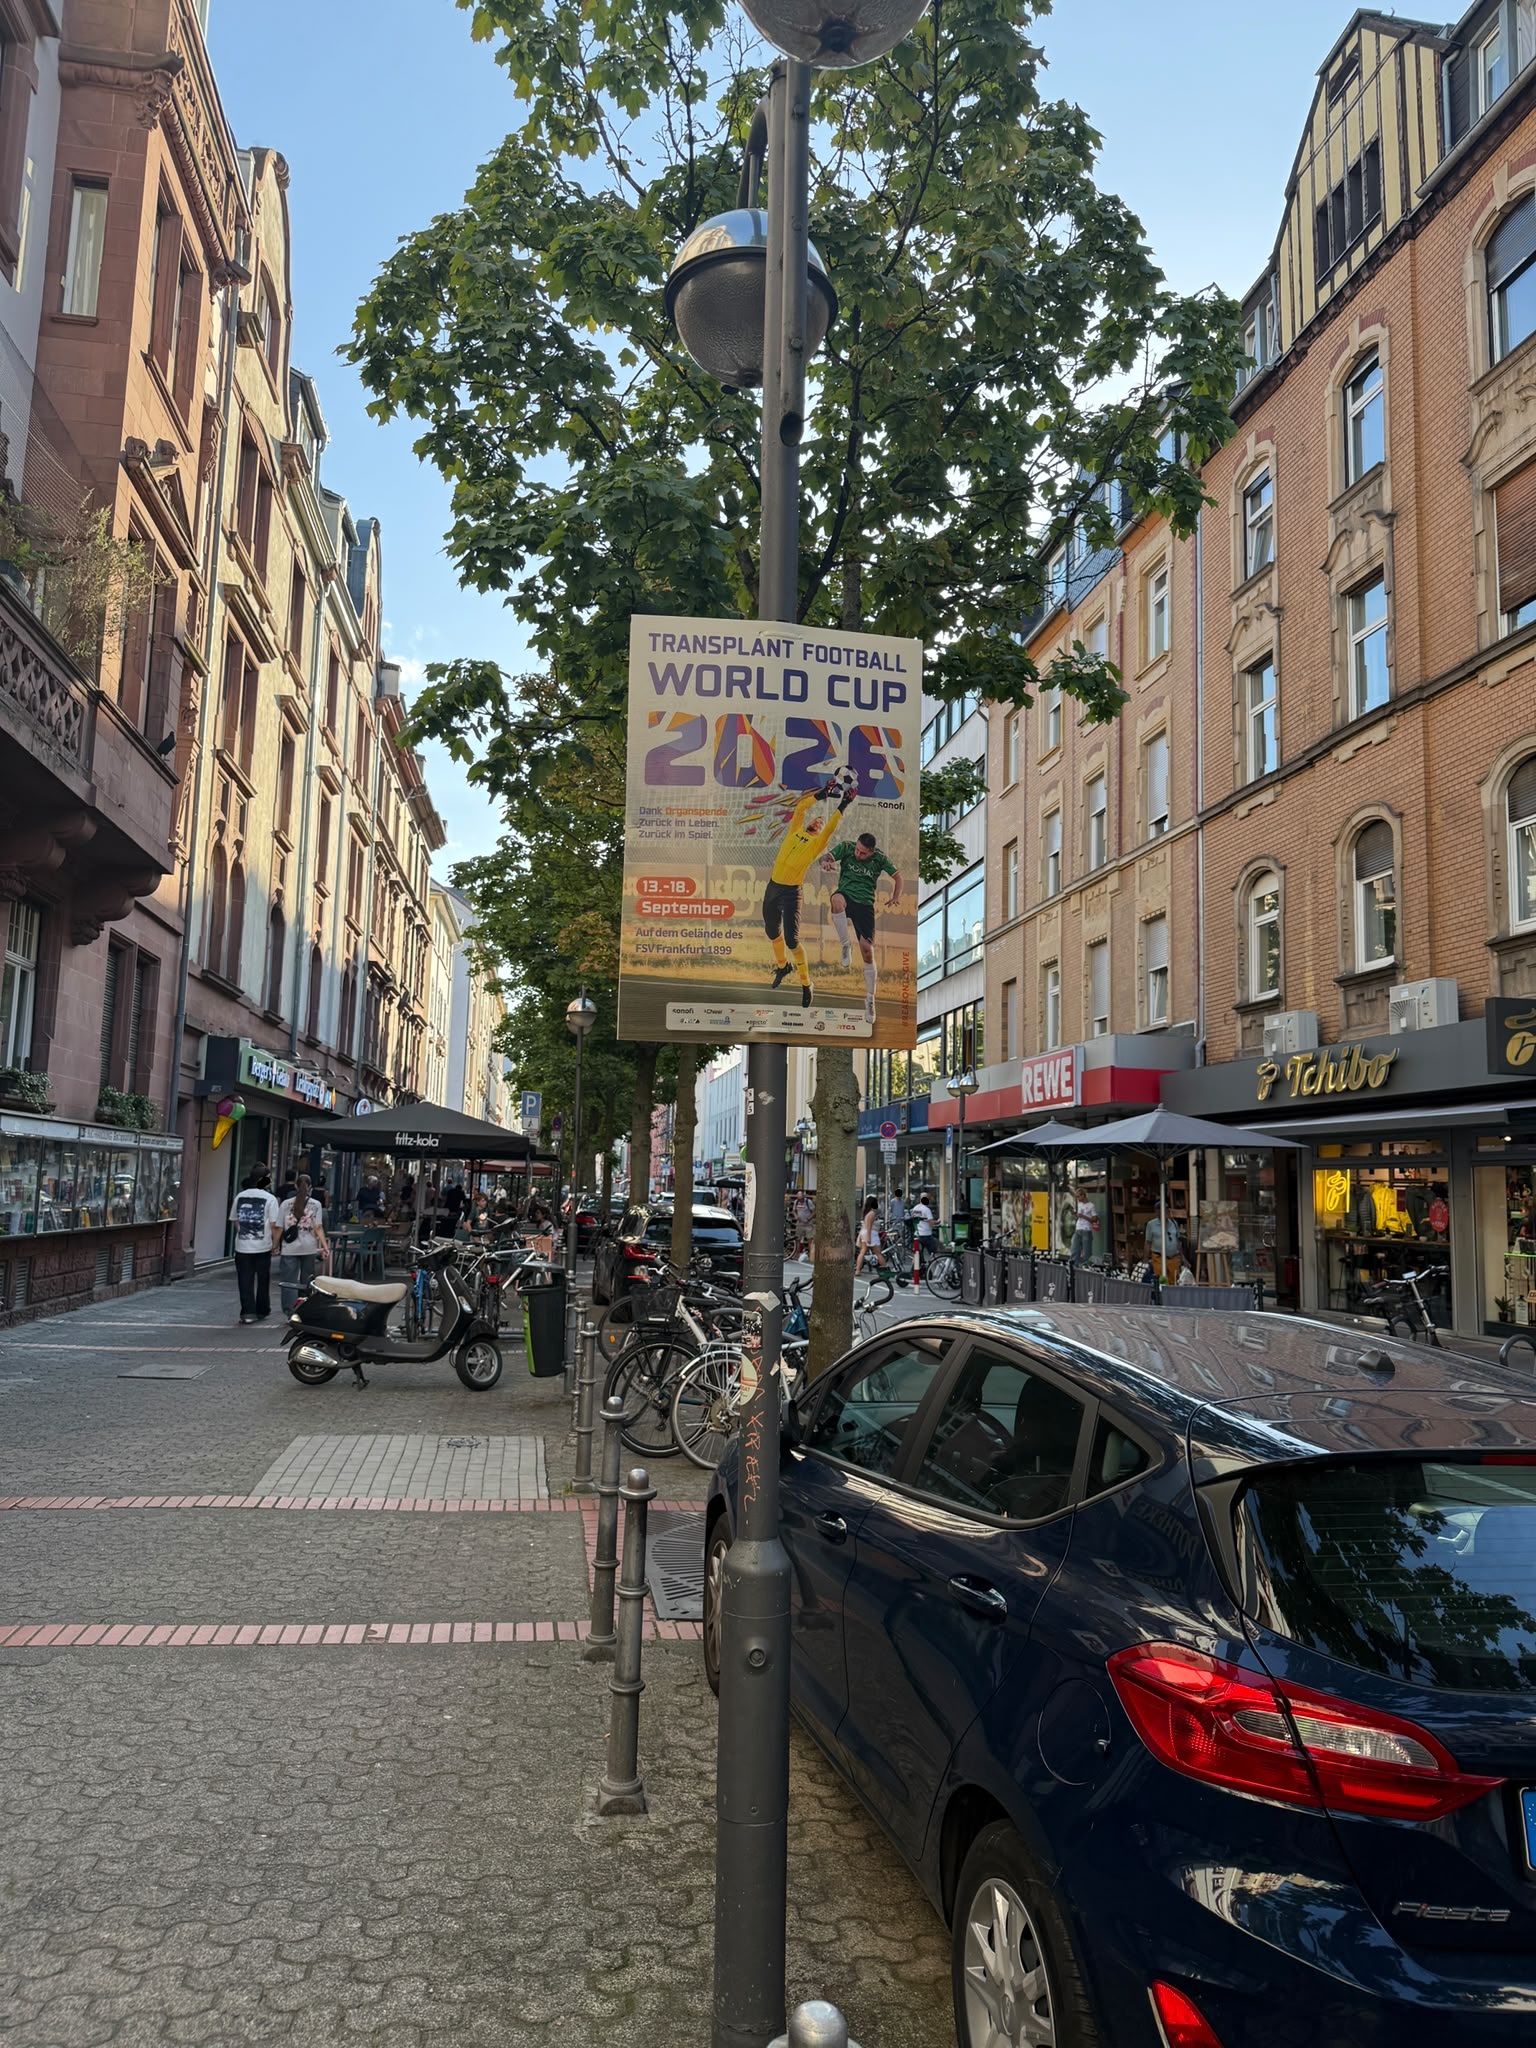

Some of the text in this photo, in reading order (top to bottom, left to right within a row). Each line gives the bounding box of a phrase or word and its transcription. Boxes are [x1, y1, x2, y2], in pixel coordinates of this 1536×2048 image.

[648, 633, 907, 673] TRANSPLANT FOOTBALL
[648, 662, 907, 713] WORLD CUP
[644, 710, 905, 799] 2026
[639, 806, 728, 817] Dank Organspende
[878, 801, 905, 811] sanofi
[639, 818, 720, 829] Zurück im Leben.
[638, 830, 714, 841] Zurück im Spiel.
[642, 880, 691, 894] 13.-18.
[641, 901, 730, 917] September
[635, 927, 744, 940] Auf dem Gelände des
[635, 943, 733, 956] FSV Frankfurt 1899
[1284, 1043, 1400, 1098] Tchibo
[1022, 1055, 1073, 1105] REWE
[525, 1094, 537, 1116] P
[395, 1131, 439, 1147] fritz-kola
[1391, 1901, 1512, 1922] Fiesta
